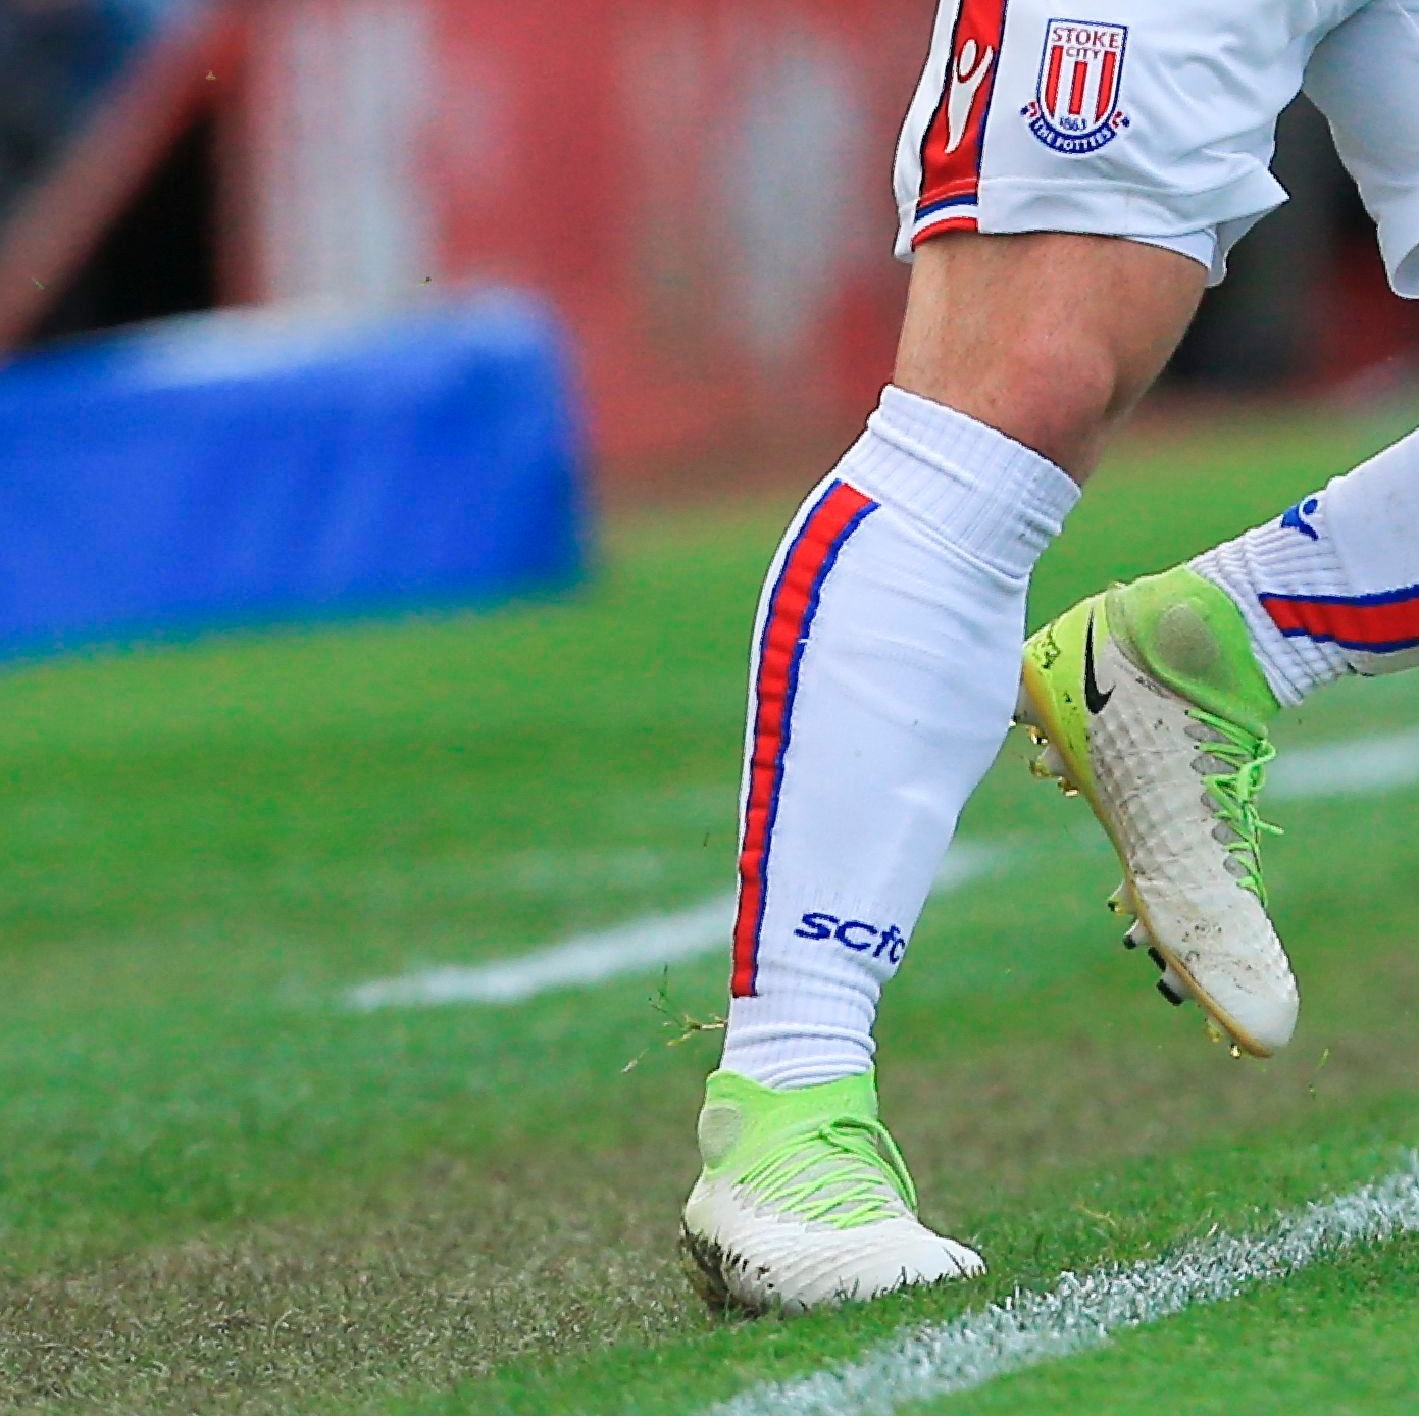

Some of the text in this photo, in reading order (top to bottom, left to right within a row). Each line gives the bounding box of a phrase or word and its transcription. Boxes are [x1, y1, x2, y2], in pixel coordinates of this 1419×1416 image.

[1052, 27, 1120, 49] STOKE
[1066, 46, 1101, 59] CITY
[794, 912, 906, 965] scfc
